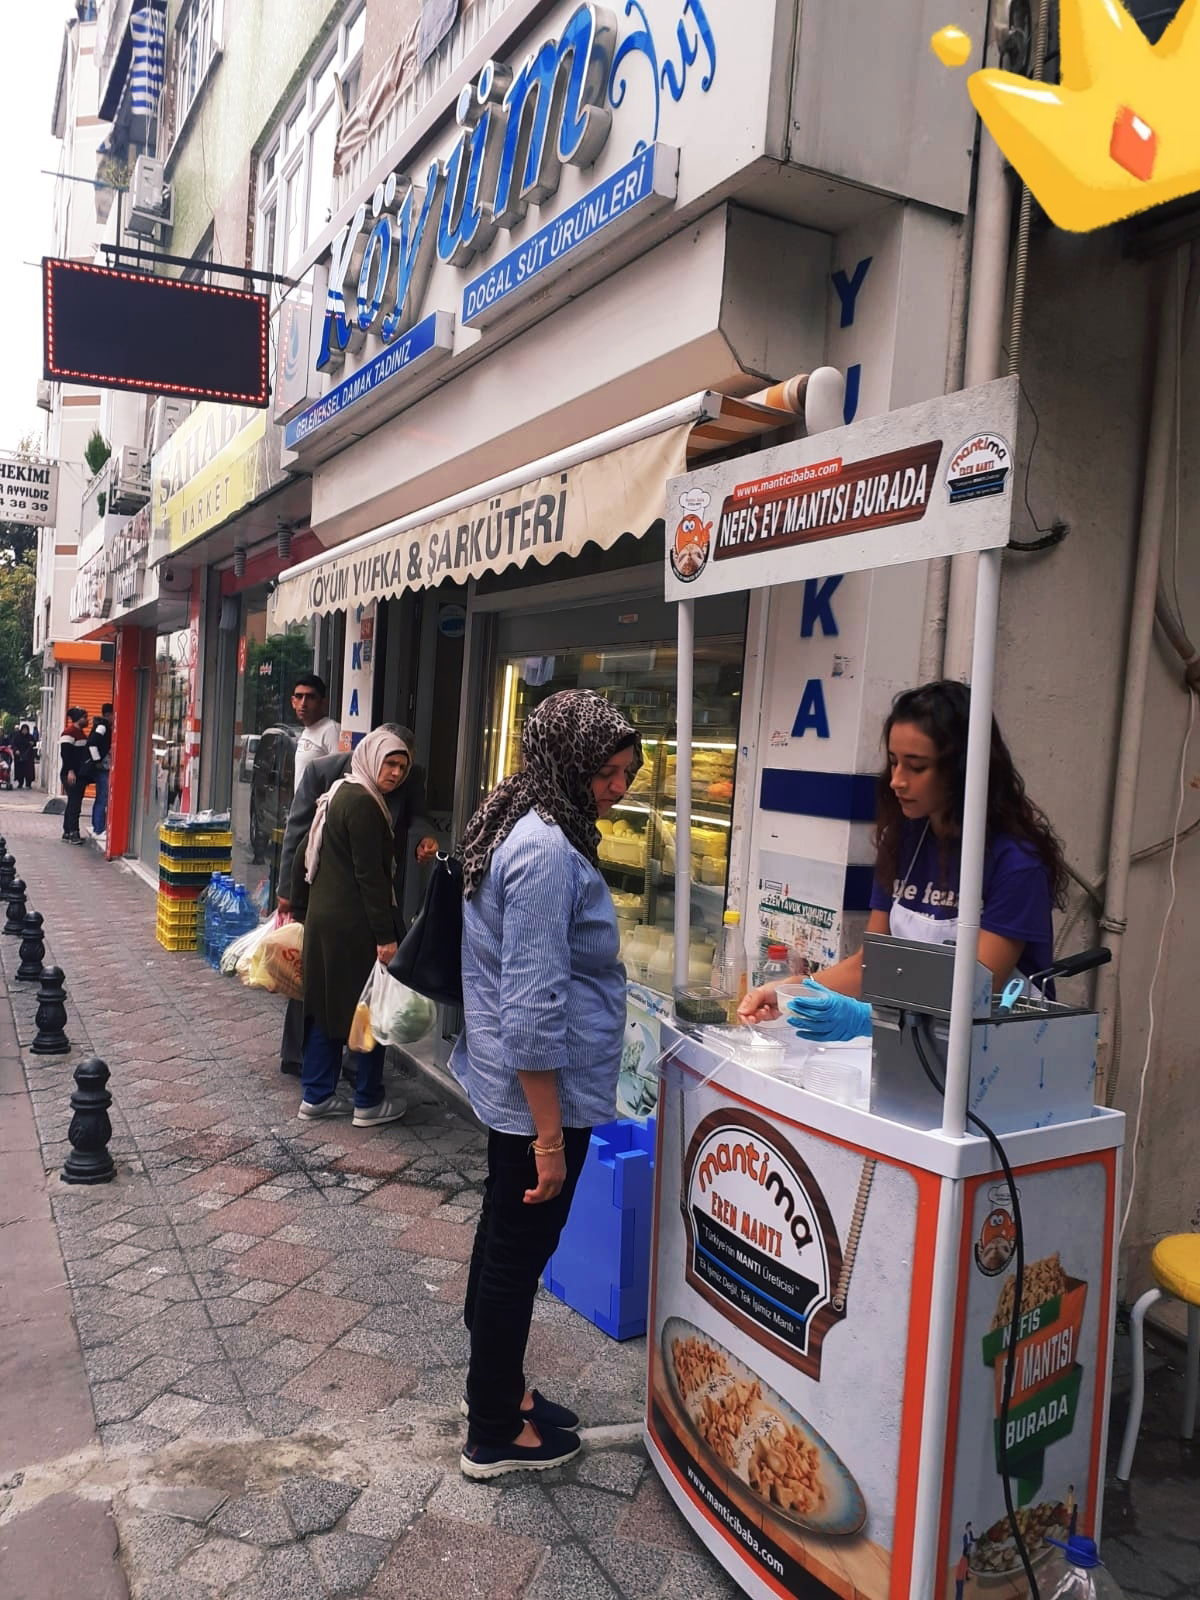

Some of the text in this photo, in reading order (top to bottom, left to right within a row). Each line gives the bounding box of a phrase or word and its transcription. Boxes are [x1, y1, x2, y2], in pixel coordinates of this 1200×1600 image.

[316, 3, 604, 370] Köyüm
[467, 156, 647, 317] DOĞAL SÜT ÜRÜNLERİ
[295, 339, 412, 439] GELENEKSEL DAMAK TADINIZ
[736, 461, 839, 498] www.manticibaba.com
[951, 436, 1007, 472] mantima
[6, 484, 49, 501] AYYILDIZ
[9, 499, 27, 509] 38
[31, 502, 49, 512] 39
[181, 476, 230, 537] MARKET
[719, 463, 928, 548] NEFİS EV MANTISI BURADA
[352, 548, 401, 596] YUFKA
[407, 540, 423, 583] &
[426, 472, 568, 585] ŞARKÜTERİ
[699, 1141, 814, 1252] mantima
[711, 1190, 783, 1258] EREN MANTI
[735, 1248, 761, 1276] MANTI
[1020, 1324, 1074, 1393] MANTISI
[1005, 1394, 1069, 1451] BURADA
[687, 1464, 785, 1578] www.manticibaba.com
